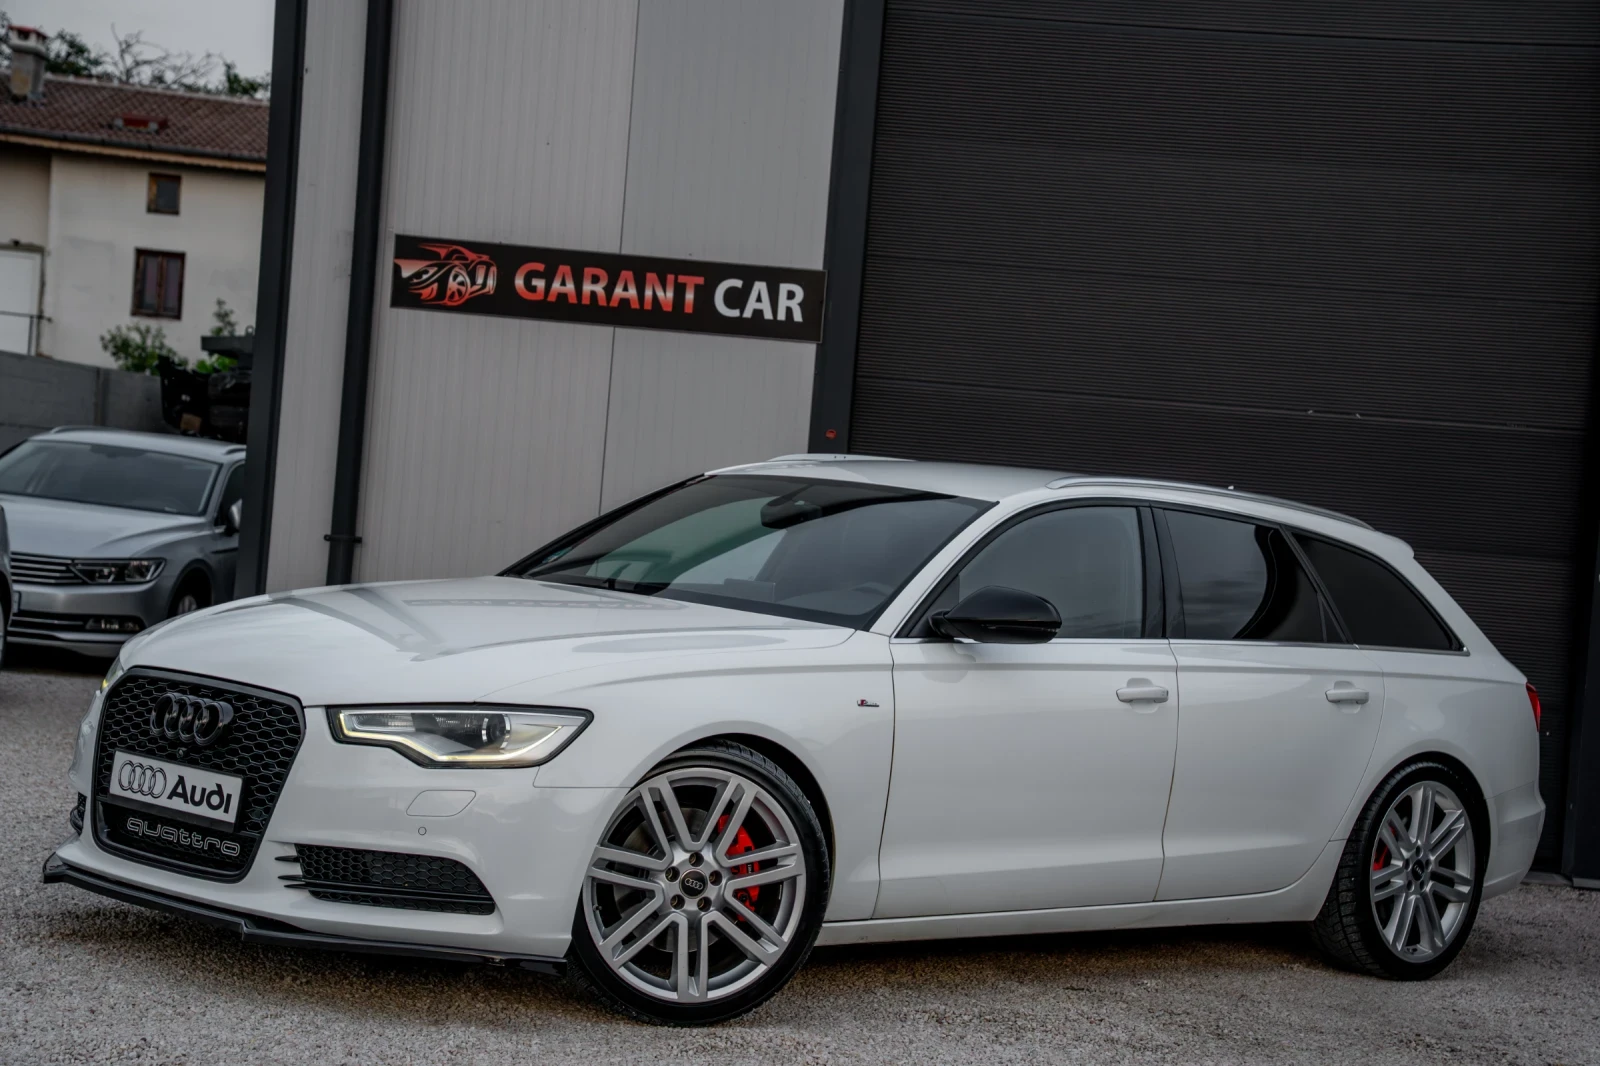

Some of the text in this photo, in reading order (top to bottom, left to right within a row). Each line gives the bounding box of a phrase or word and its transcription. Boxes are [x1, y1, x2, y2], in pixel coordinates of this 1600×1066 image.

[515, 262, 805, 322] GARANT CAR
[167, 775, 233, 814] Audi
[127, 818, 241, 857] quattro
